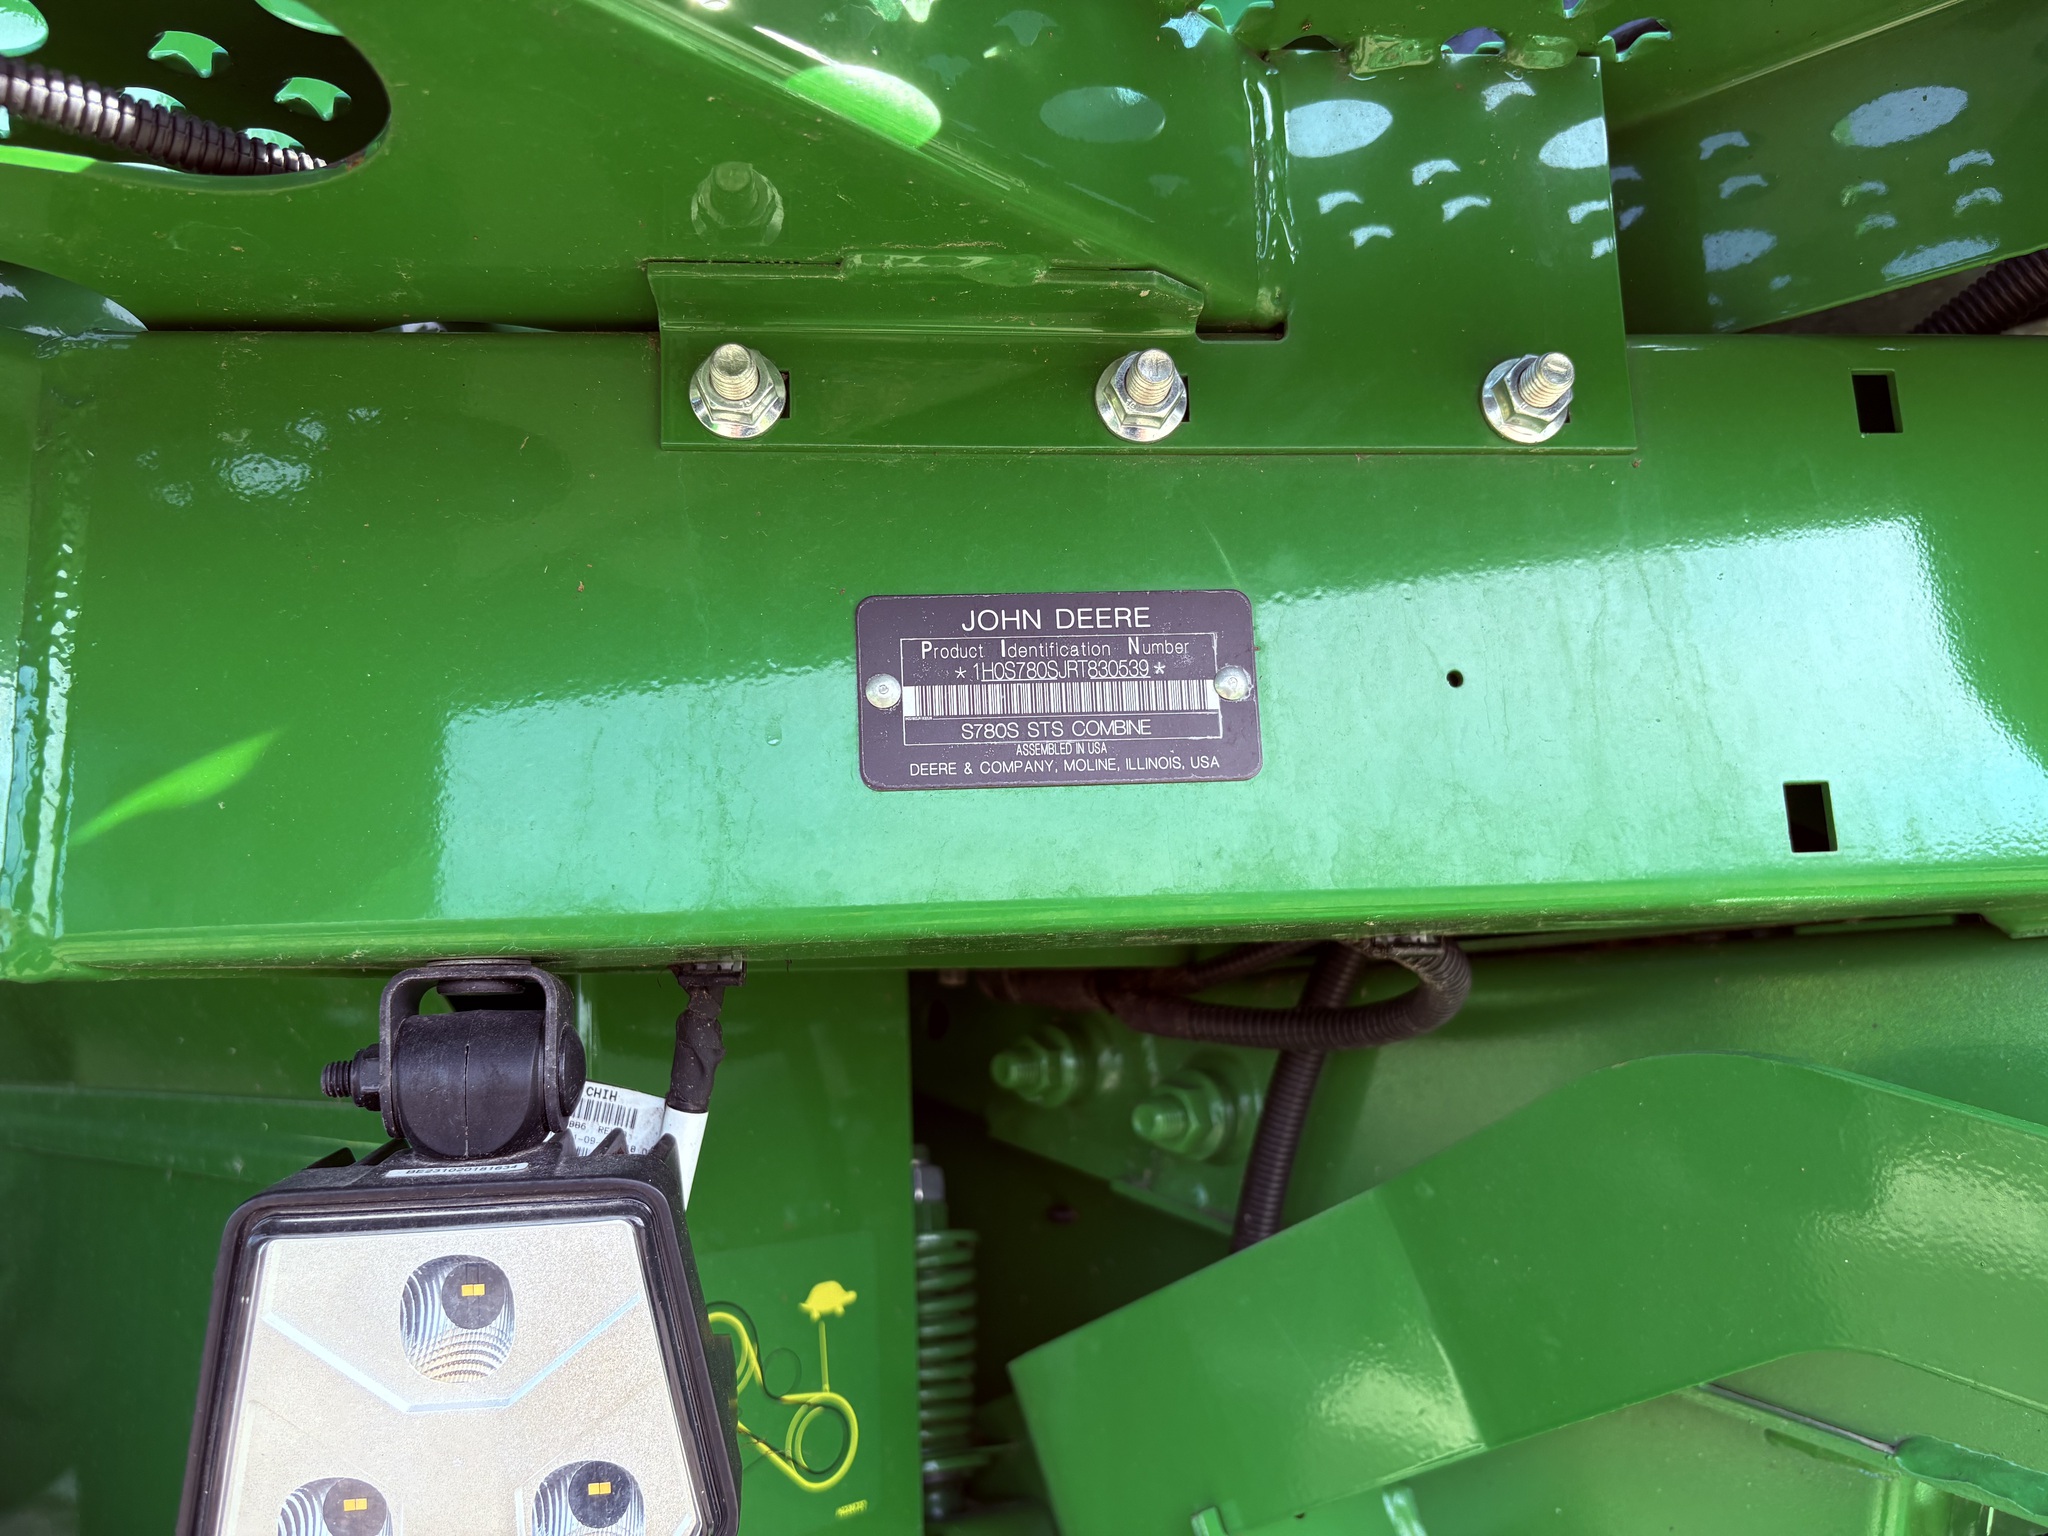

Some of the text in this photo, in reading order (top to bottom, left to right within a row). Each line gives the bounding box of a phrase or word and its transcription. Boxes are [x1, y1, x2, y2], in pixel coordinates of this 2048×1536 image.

[961, 607, 1151, 632] JOHN DEERE
[921, 636, 1190, 660] Product Identification Number
[961, 719, 1152, 740] S780S STS COMBINE
[1016, 741, 1108, 757] ASSEMBLED IN USA
[909, 755, 1220, 777] DEERE & COMPANY, MOLINE, ILLINOIS, USA
[585, 1086, 619, 1102] CHIH
